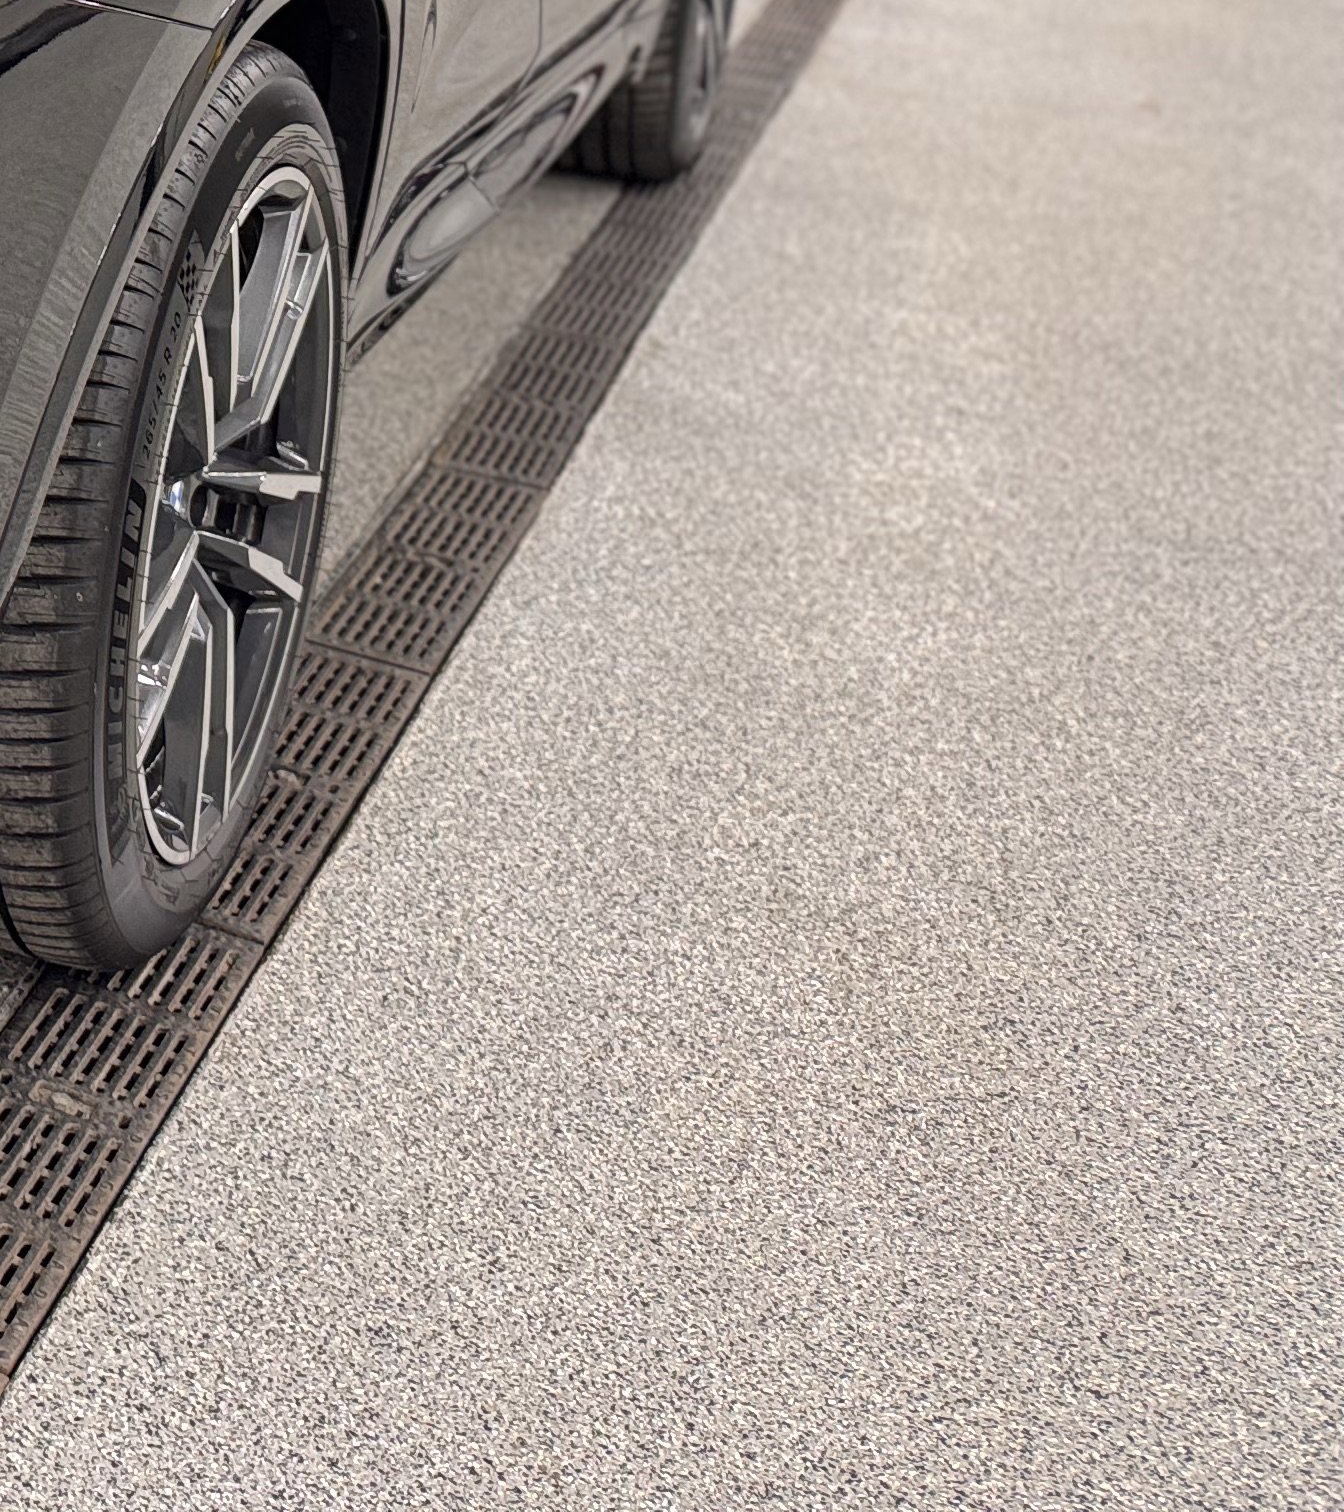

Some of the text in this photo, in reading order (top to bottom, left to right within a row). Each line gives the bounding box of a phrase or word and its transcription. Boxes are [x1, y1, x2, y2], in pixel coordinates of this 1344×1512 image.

[142, 311, 182, 460] 265/45 R 20
[107, 497, 143, 780] MICHELIN
